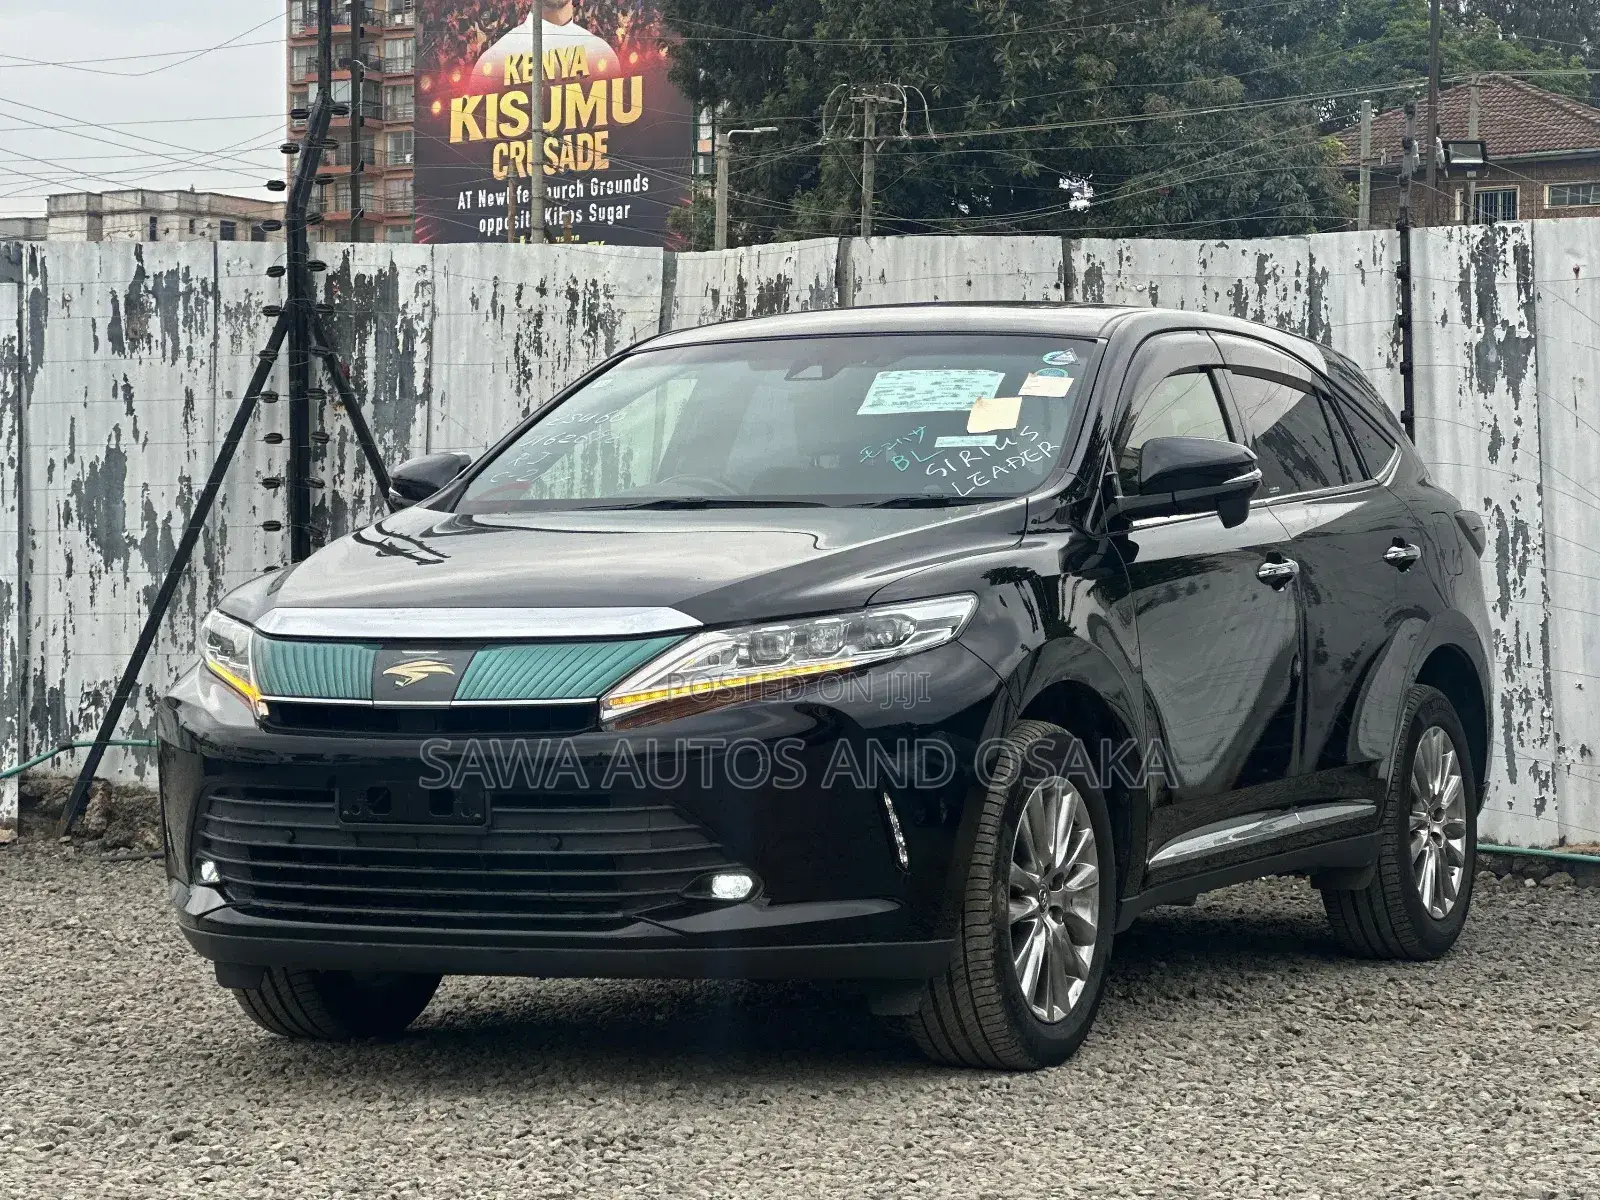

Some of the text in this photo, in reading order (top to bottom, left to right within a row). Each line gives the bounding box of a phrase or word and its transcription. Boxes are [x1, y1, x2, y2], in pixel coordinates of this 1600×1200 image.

[504, 44, 591, 85] KENYA
[450, 76, 643, 143] KISUMU
[457, 191, 473, 210] AT
[590, 173, 650, 197] Grounds
[589, 203, 631, 225] Sugar
[925, 425, 1039, 477] SIRIUS
[951, 441, 1060, 497] LEADER
